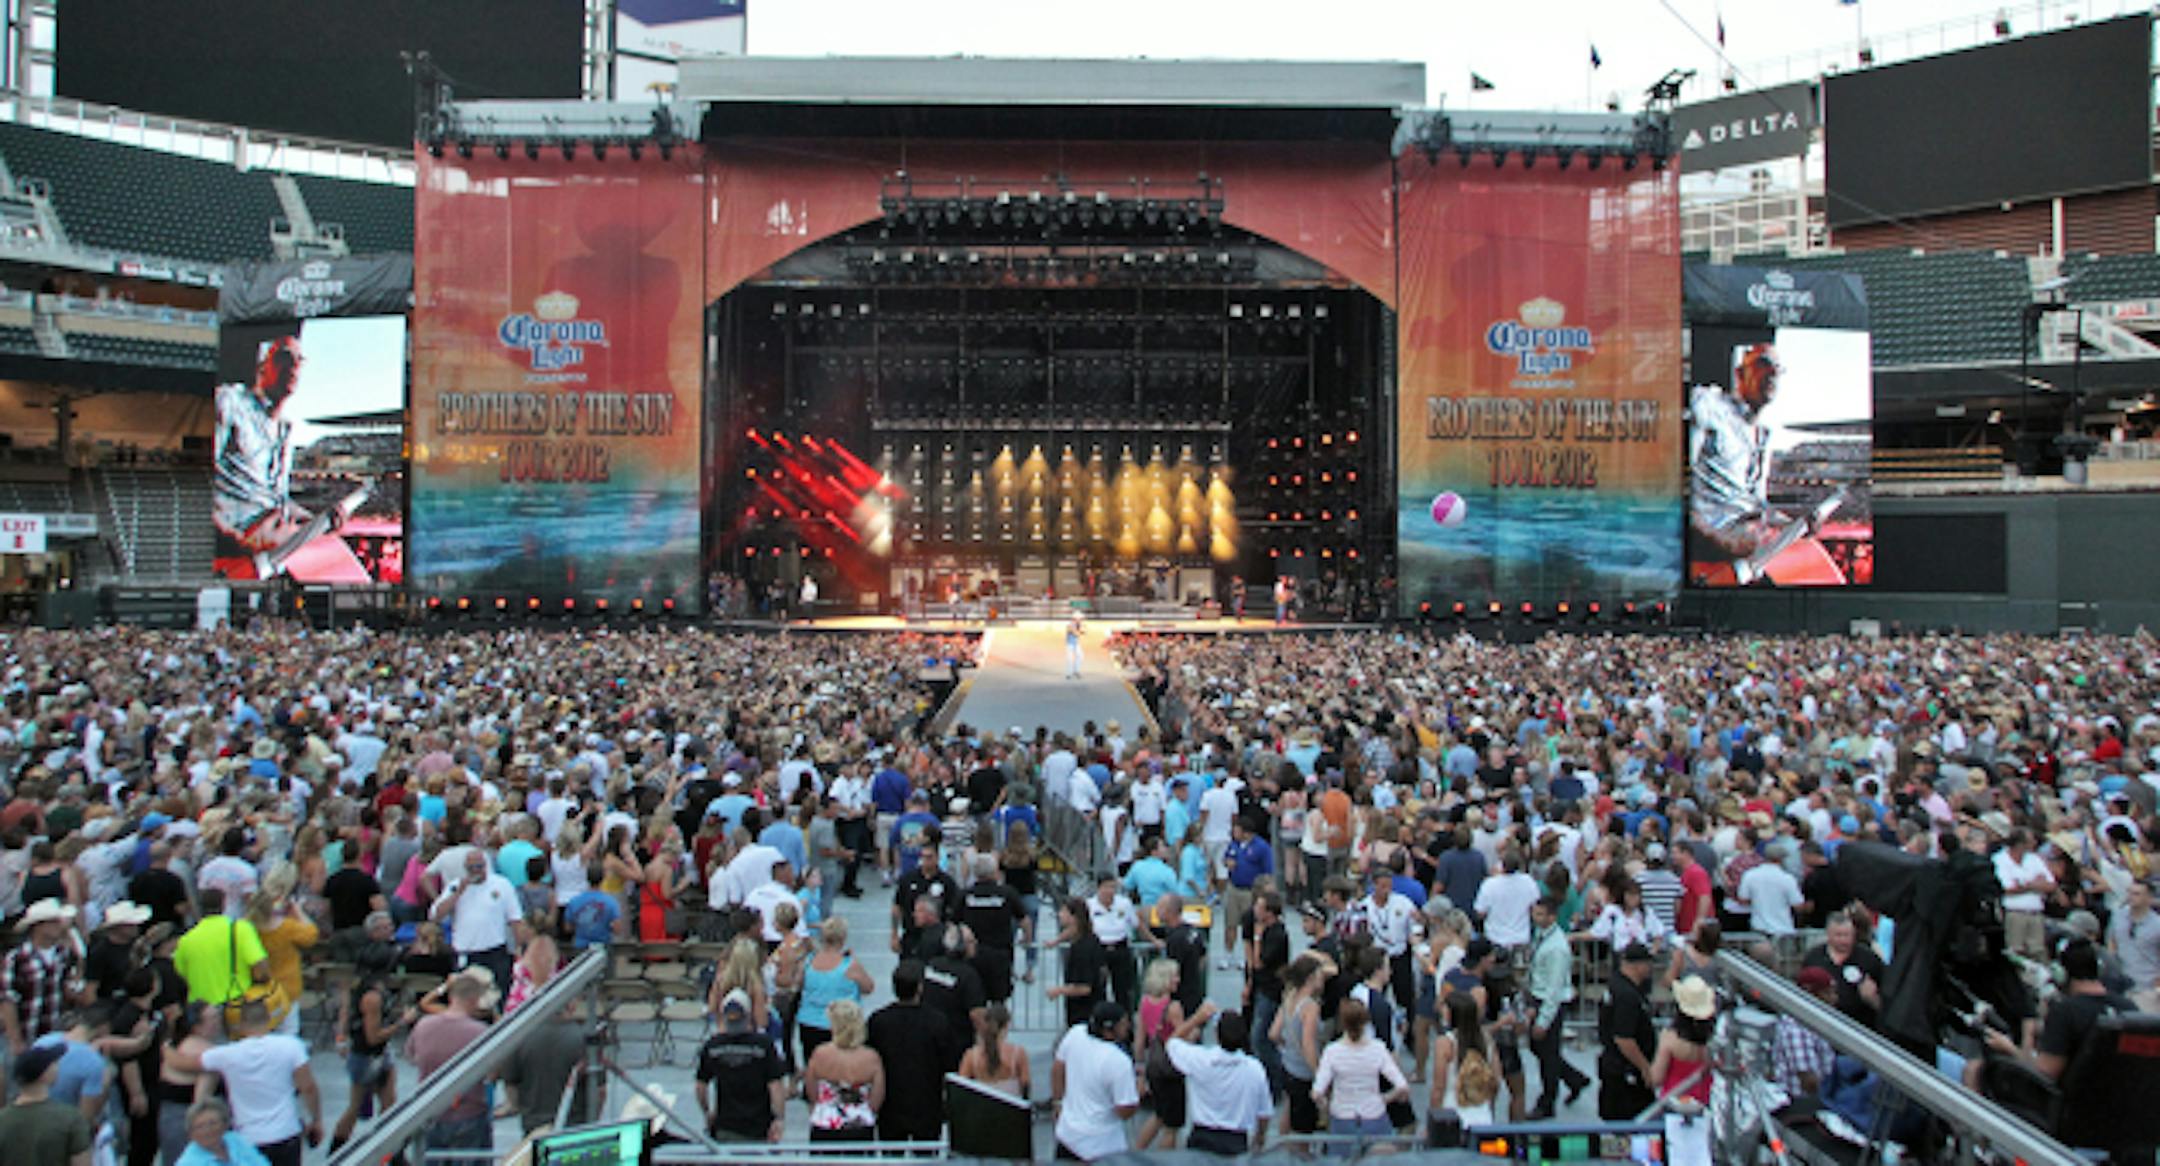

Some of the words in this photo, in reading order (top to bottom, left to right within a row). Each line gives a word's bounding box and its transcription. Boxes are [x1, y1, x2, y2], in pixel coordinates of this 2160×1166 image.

[1708, 111, 1799, 143] DELTA
[499, 314, 605, 347] Corona
[1487, 321, 1593, 354] Corona
[531, 343, 583, 370] Light
[1517, 349, 1573, 375] Light
[438, 391, 547, 435] BROTHERS
[551, 391, 580, 435] OF
[584, 391, 630, 435] THE
[631, 393, 674, 435] SUN
[1426, 396, 1537, 440] BROTHERS
[1540, 397, 1570, 441] OF
[1572, 397, 1616, 441] THE
[1617, 398, 1660, 441] SUN
[503, 441, 557, 482] TOUR
[560, 441, 608, 482] 2012
[1489, 449, 1546, 488] TOUR
[1549, 449, 1598, 488] 2012
[2, 518, 37, 533] EXIT
